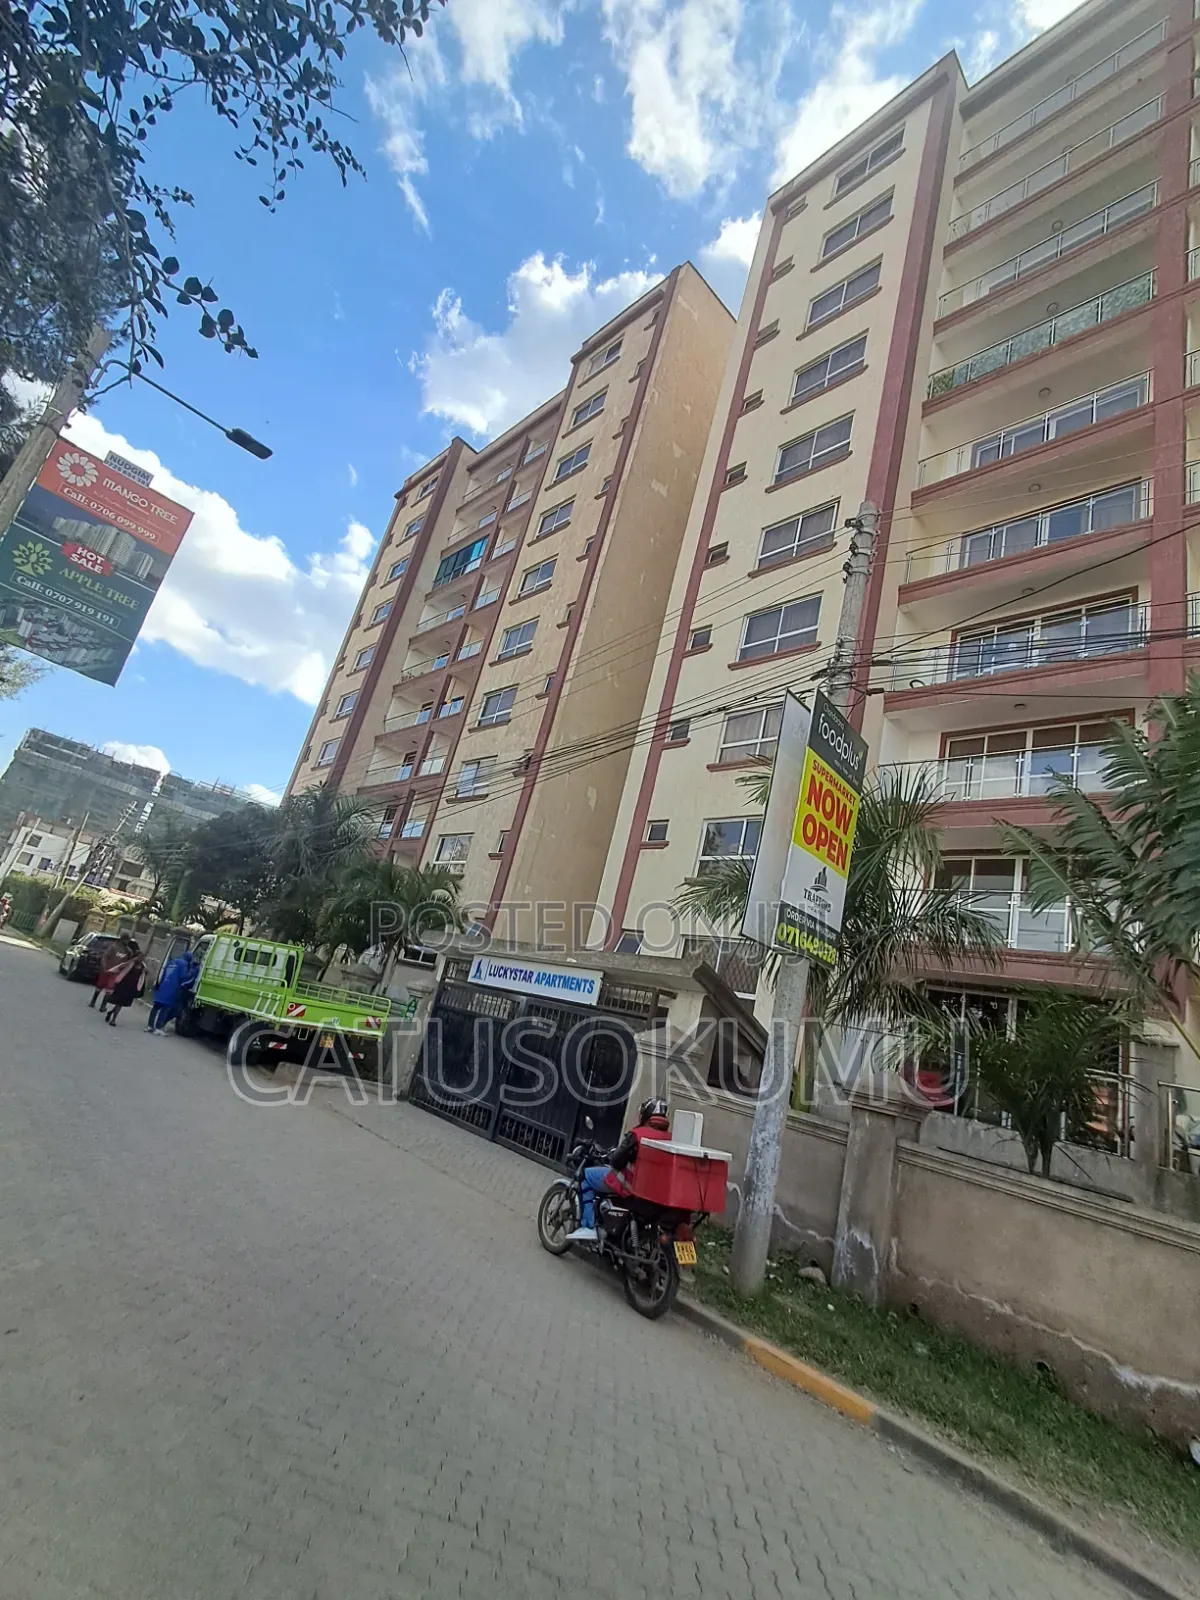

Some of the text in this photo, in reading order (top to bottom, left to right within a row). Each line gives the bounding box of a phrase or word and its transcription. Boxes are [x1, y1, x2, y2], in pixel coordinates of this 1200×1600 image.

[109, 454, 150, 481] NUDGIM
[63, 486, 88, 505] Call:
[90, 501, 116, 520] 0706
[117, 515, 136, 530] 099
[137, 526, 156, 541] 999
[102, 477, 149, 507] MANGO
[150, 502, 178, 525] TREE
[70, 553, 104, 574] SALE
[76, 546, 105, 564] HOT
[16, 575, 44, 593] Call:
[45, 588, 74, 605] 0707
[75, 601, 95, 615] 919
[96, 612, 115, 625] 191
[59, 567, 105, 593] APPLE
[107, 587, 140, 610] TREE
[818, 713, 860, 770] foodplus
[806, 773, 854, 836] NOW
[812, 759, 856, 806] SUPERMARKET
[802, 813, 849, 871] OPEN
[786, 909, 806, 925] ORDER
[806, 919, 815, 930] VIA
[488, 964, 596, 994] LUCKYSTAR APARTMENTS
